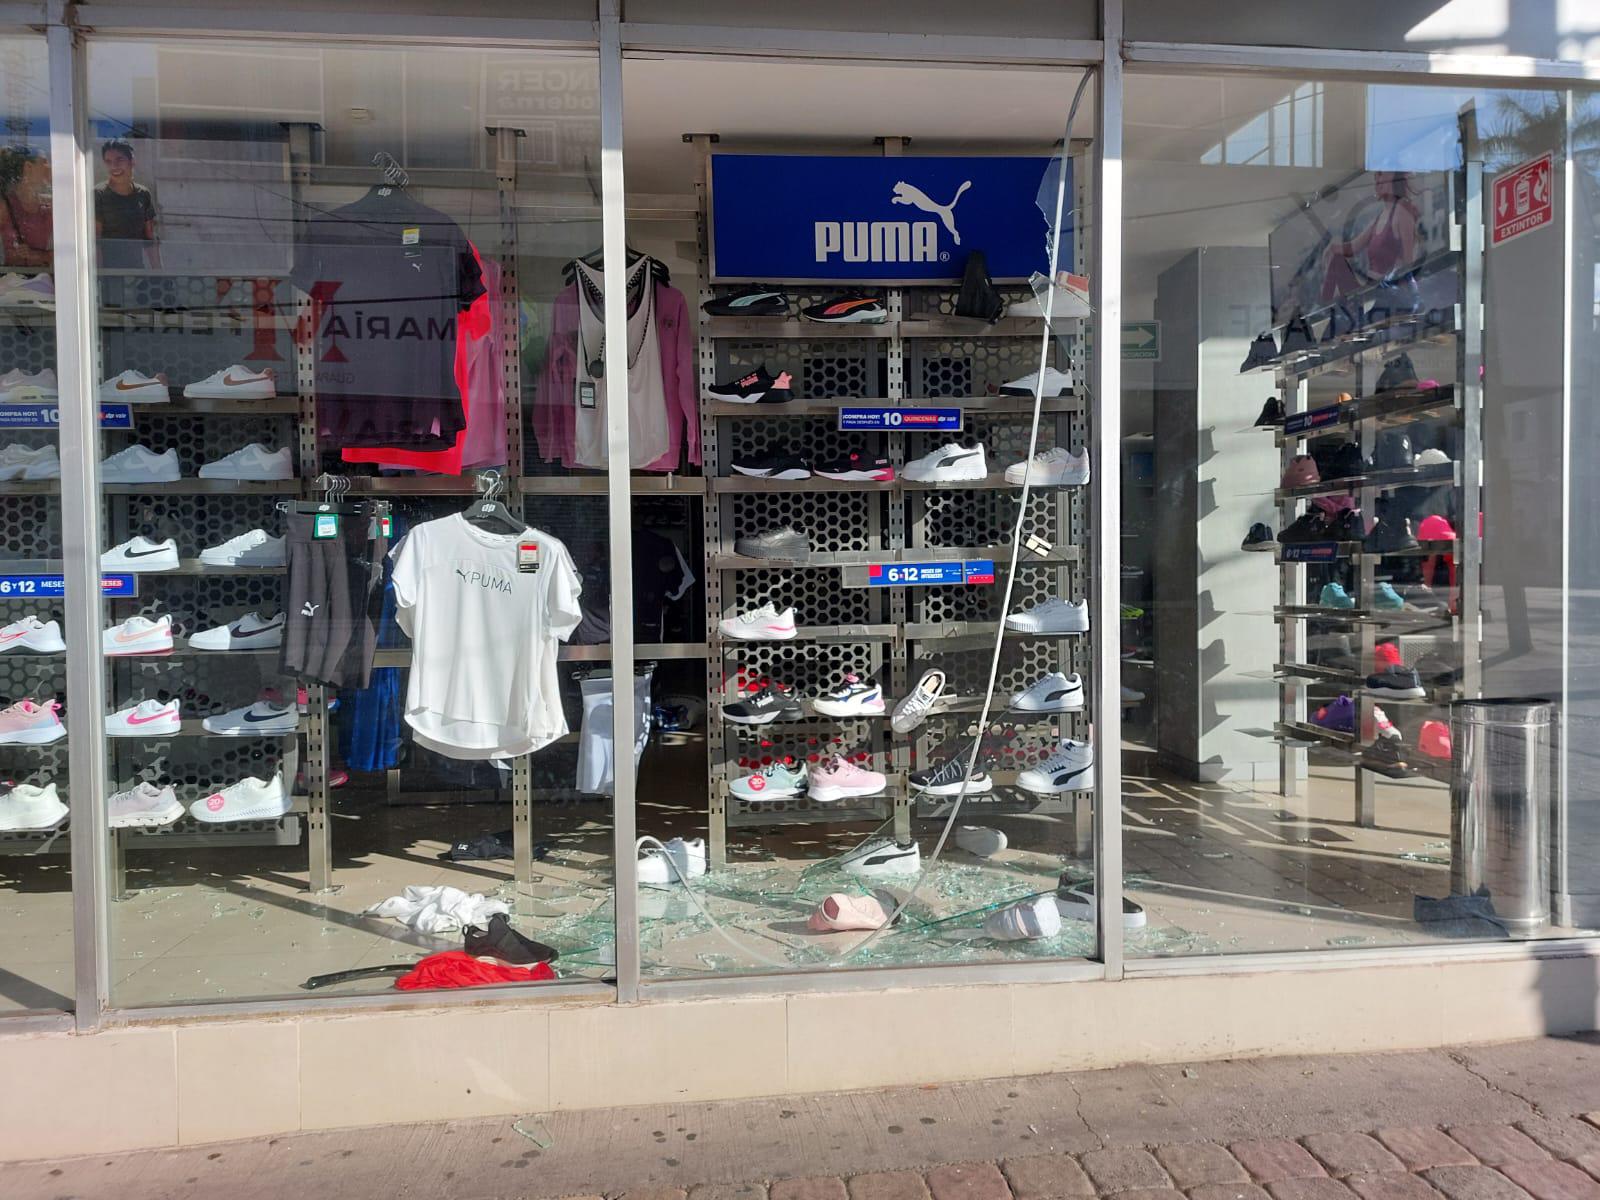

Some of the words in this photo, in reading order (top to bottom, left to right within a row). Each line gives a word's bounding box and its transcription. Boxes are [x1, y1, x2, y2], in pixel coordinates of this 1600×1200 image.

[1501, 212, 1543, 238] EXTINTOR
[815, 221, 938, 262] PUMA
[882, 412, 902, 426] 10
[471, 571, 512, 596] PUMA
[888, 568, 899, 582] 6
[903, 567, 919, 581] 12
[0, 580, 11, 593] 6
[18, 580, 36, 593] 12
